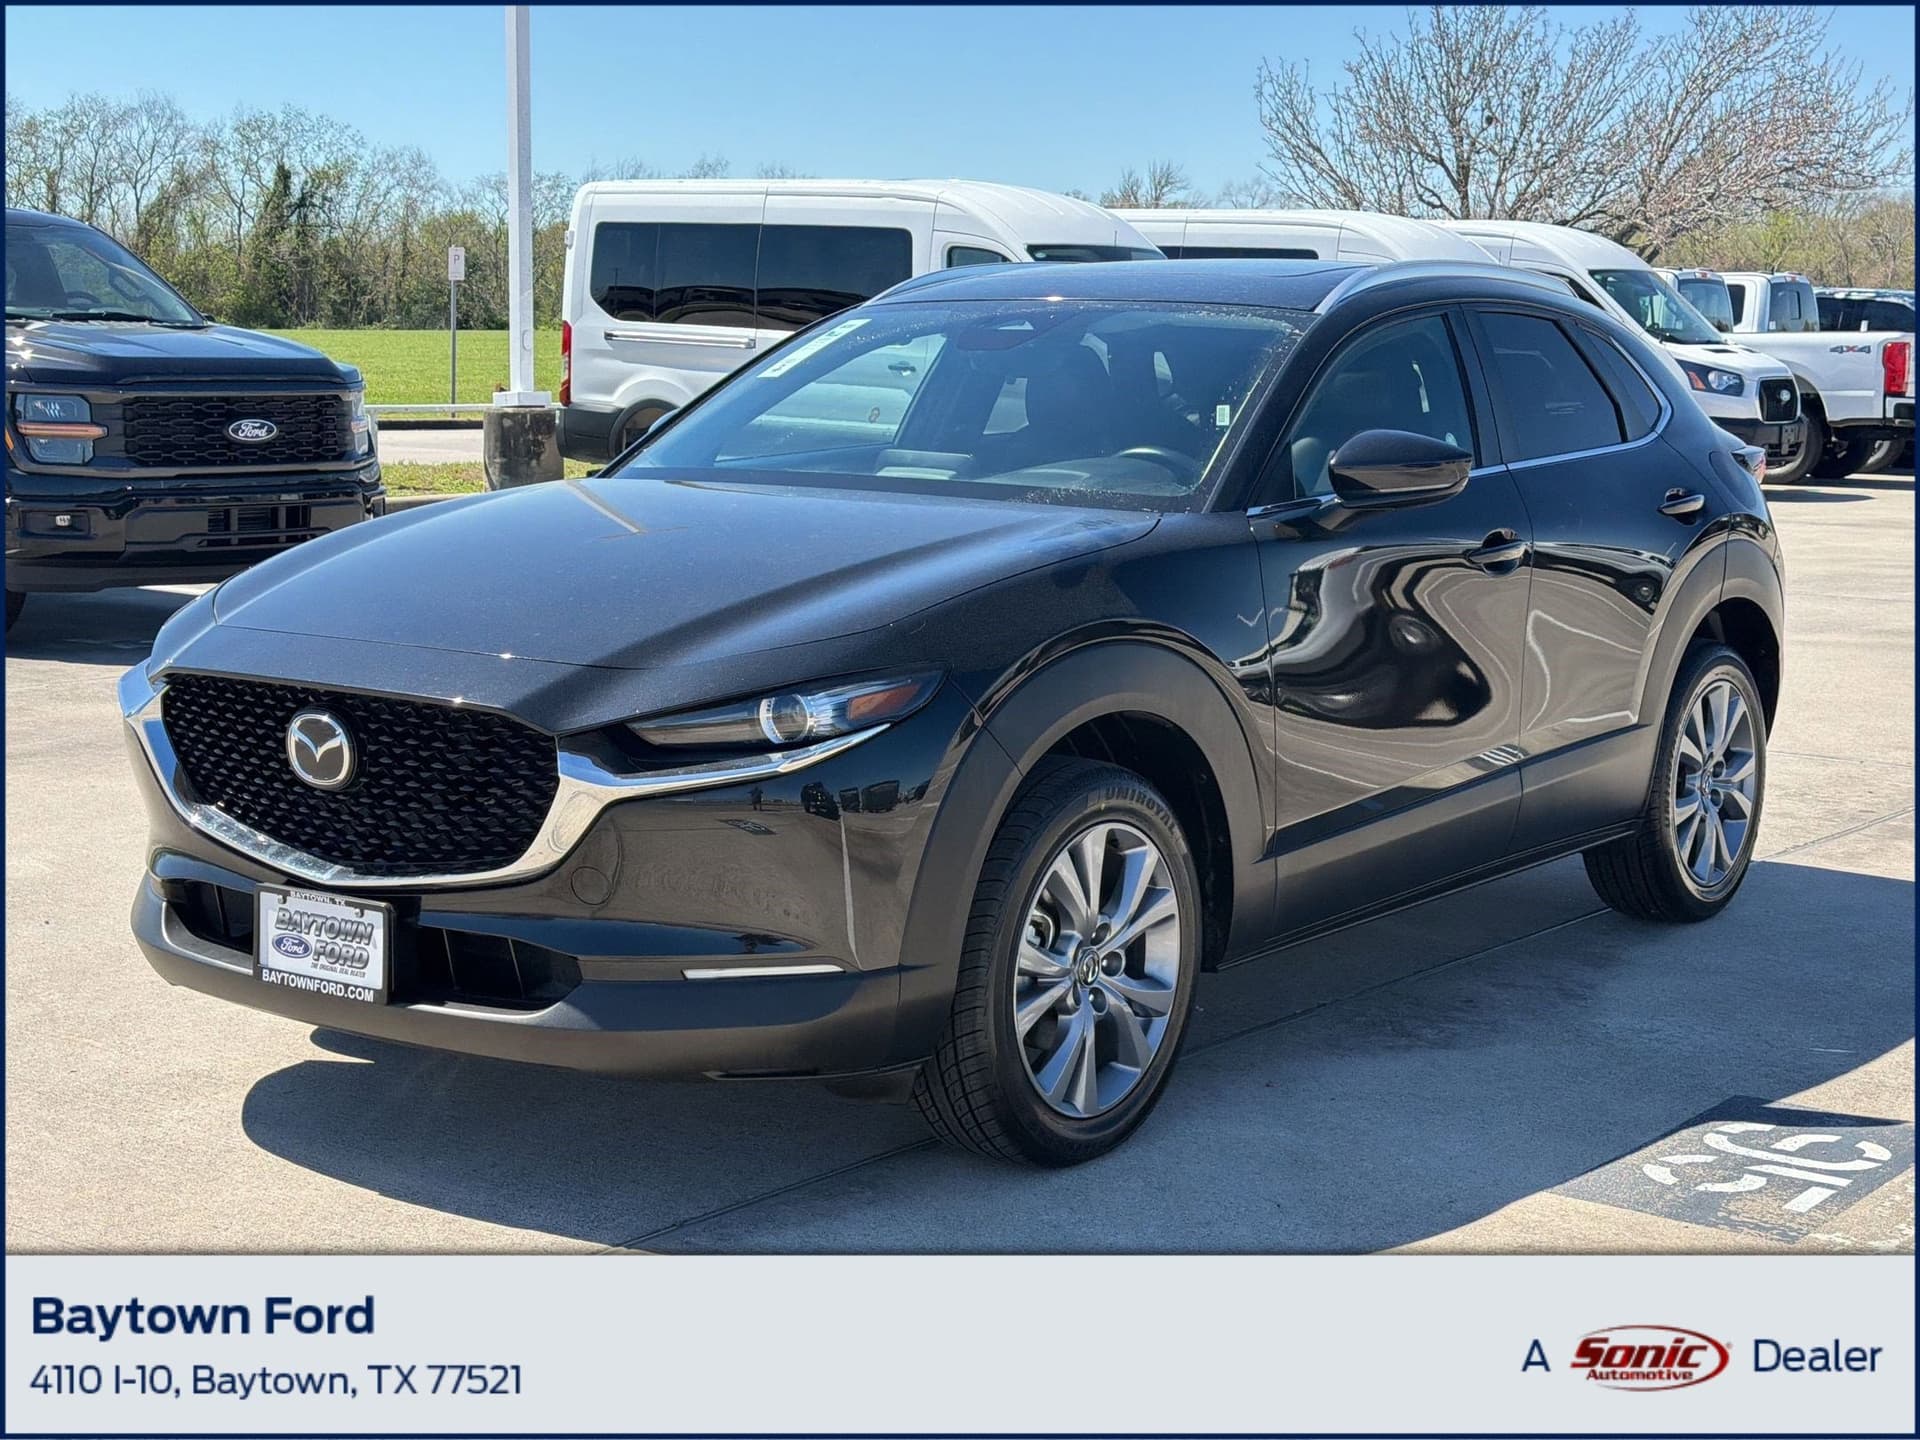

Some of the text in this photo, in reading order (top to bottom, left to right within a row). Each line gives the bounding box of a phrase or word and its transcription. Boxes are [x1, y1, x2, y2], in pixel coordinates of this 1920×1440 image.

[238, 422, 268, 437] Ford
[1103, 785, 1177, 835] UNIROYAL
[275, 908, 374, 946] BAYTOWN
[280, 937, 305, 954] Ford
[312, 939, 370, 970] FORD
[262, 970, 374, 1002] BAYTOWNFORD.COM
